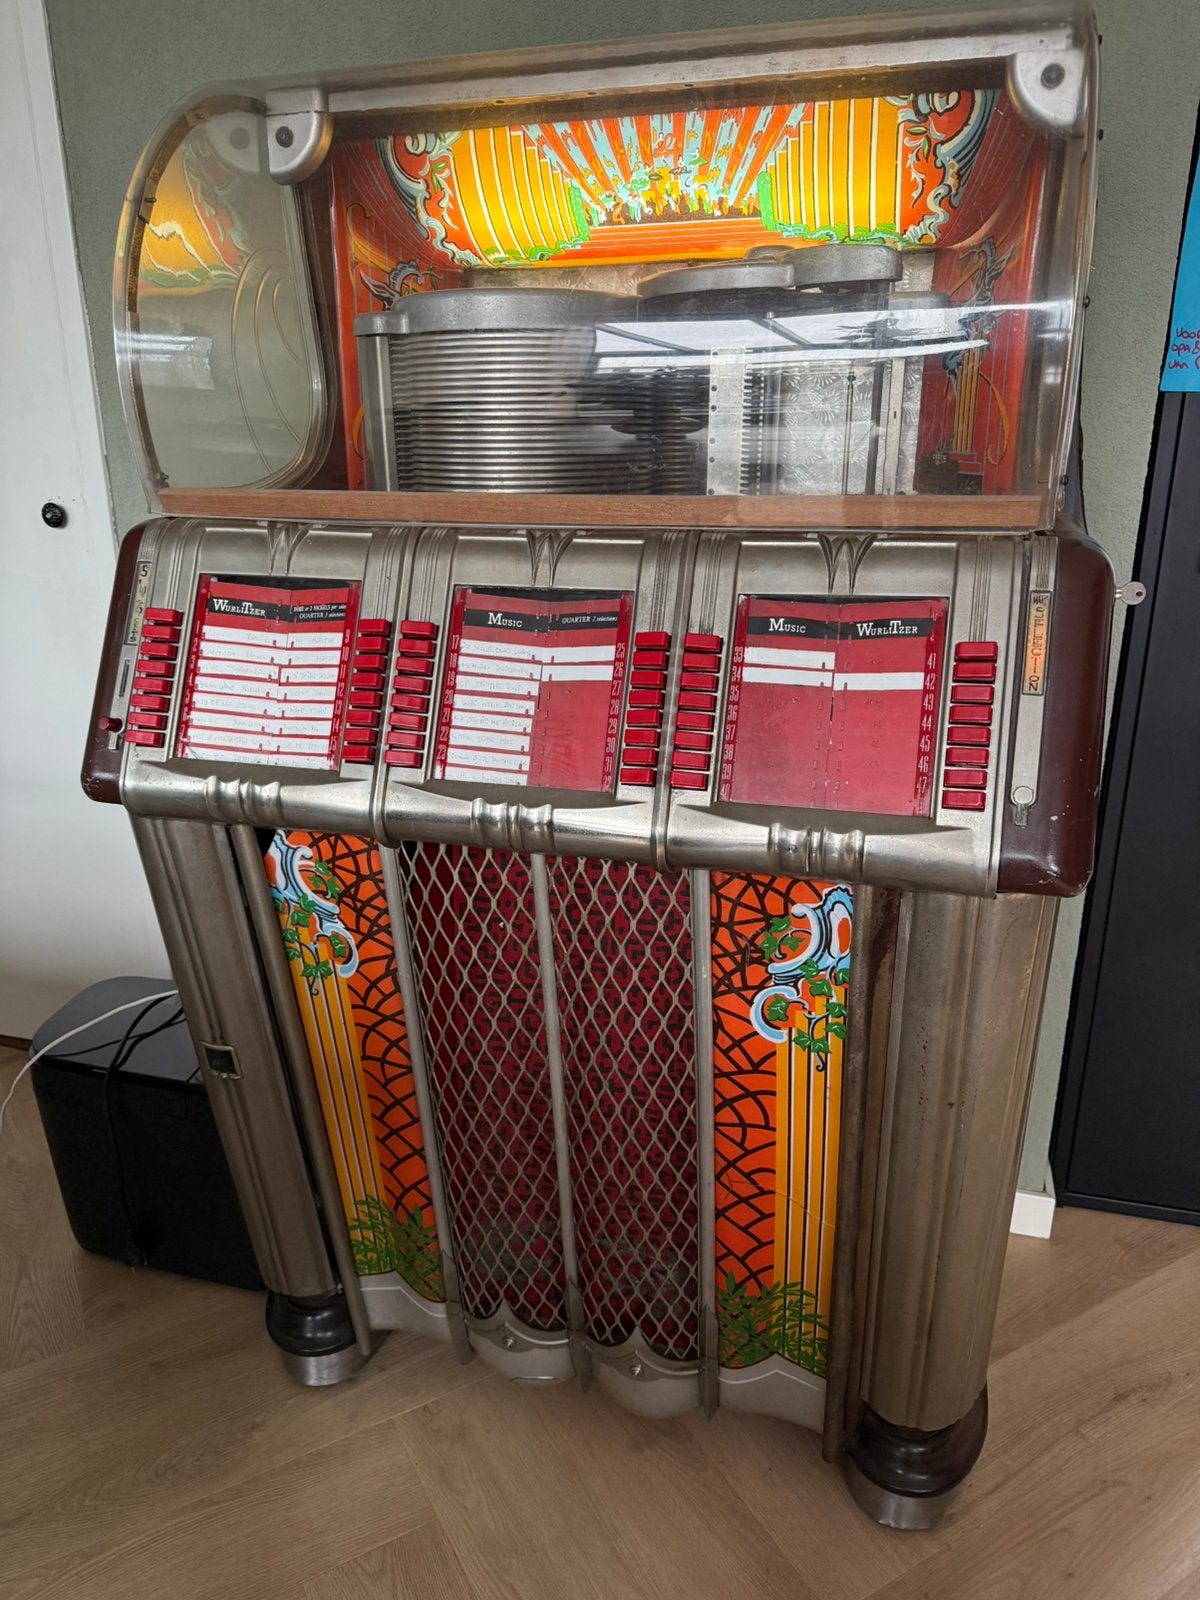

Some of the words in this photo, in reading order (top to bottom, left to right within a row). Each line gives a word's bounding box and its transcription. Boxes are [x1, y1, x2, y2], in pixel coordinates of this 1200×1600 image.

[488, 612, 523, 628] MUSIC
[562, 616, 590, 624] QUARTER
[768, 618, 806, 634] MUSIC
[193, 640, 198, 651] 2
[452, 634, 459, 650] 17
[342, 647, 349, 661] 10
[616, 643, 626, 659] 25
[734, 648, 744, 663] 33
[190, 657, 195, 669] 3
[449, 653, 457, 668] 18
[927, 653, 936, 669] 41
[339, 665, 346, 678] 11
[614, 662, 623, 677] 26
[732, 667, 742, 682] 34
[447, 671, 455, 686] 19
[925, 674, 936, 690] 42
[336, 683, 344, 697] 12
[612, 681, 621, 696] 27
[729, 686, 739, 701] 35
[444, 690, 453, 705] 20
[923, 694, 934, 710] 43
[334, 700, 342, 714] 13
[610, 700, 619, 715] 28
[728, 705, 737, 720] 36
[442, 708, 451, 723] 21
[921, 715, 932, 731] 44
[332, 718, 340, 732] 14
[608, 719, 617, 734] 29
[440, 726, 448, 741] 22
[726, 726, 736, 741] 37
[606, 738, 615, 753] 30
[919, 736, 931, 751] 45
[437, 744, 446, 760] 23
[724, 745, 733, 760] 38
[604, 757, 613, 771] 31
[918, 756, 929, 772] 46
[721, 765, 732, 780] 39
[916, 777, 927, 794] 47
